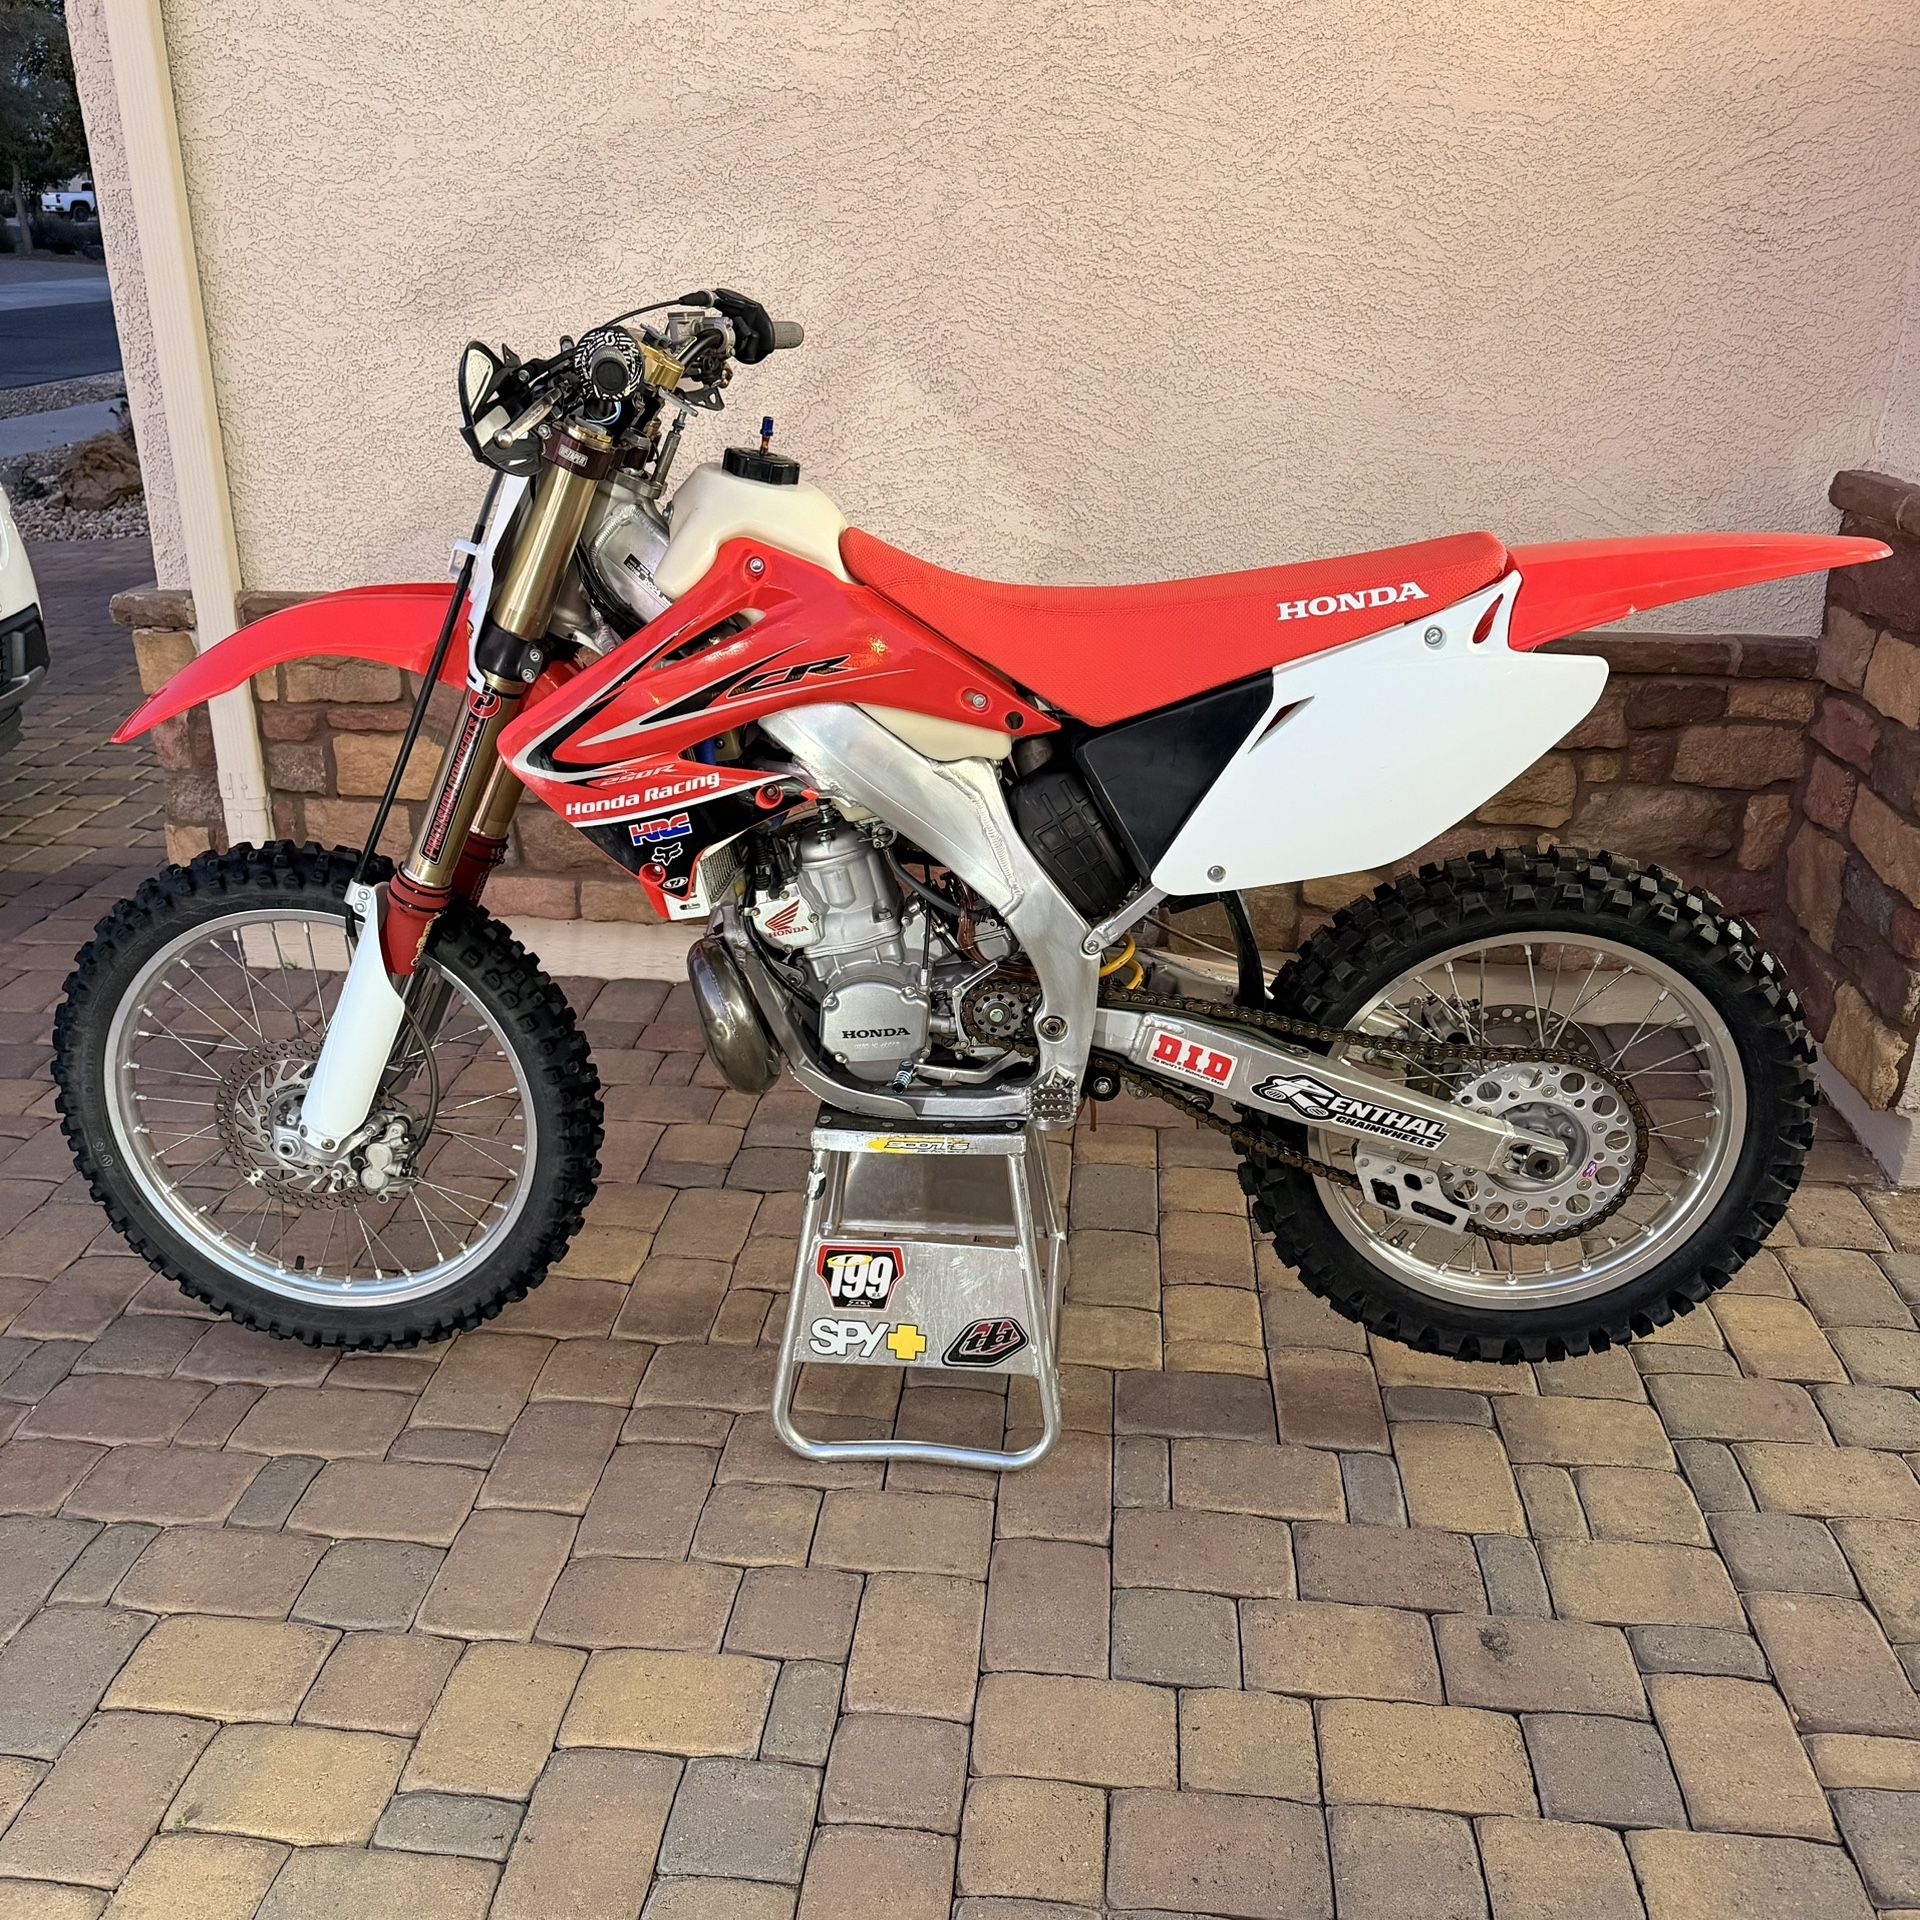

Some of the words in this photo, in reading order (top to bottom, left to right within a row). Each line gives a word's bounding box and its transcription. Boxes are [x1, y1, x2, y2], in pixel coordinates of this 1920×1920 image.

[1276, 581, 1429, 621] HONDA
[599, 763, 679, 787] 250R
[565, 793, 640, 816] Honda
[644, 772, 720, 803] Racing
[628, 812, 693, 846] HRC
[768, 925, 809, 938] HONDA
[841, 1027, 911, 1039] HONDA
[1335, 1115, 1438, 1149] CHAINWHEELS
[827, 1255, 894, 1299] 199
